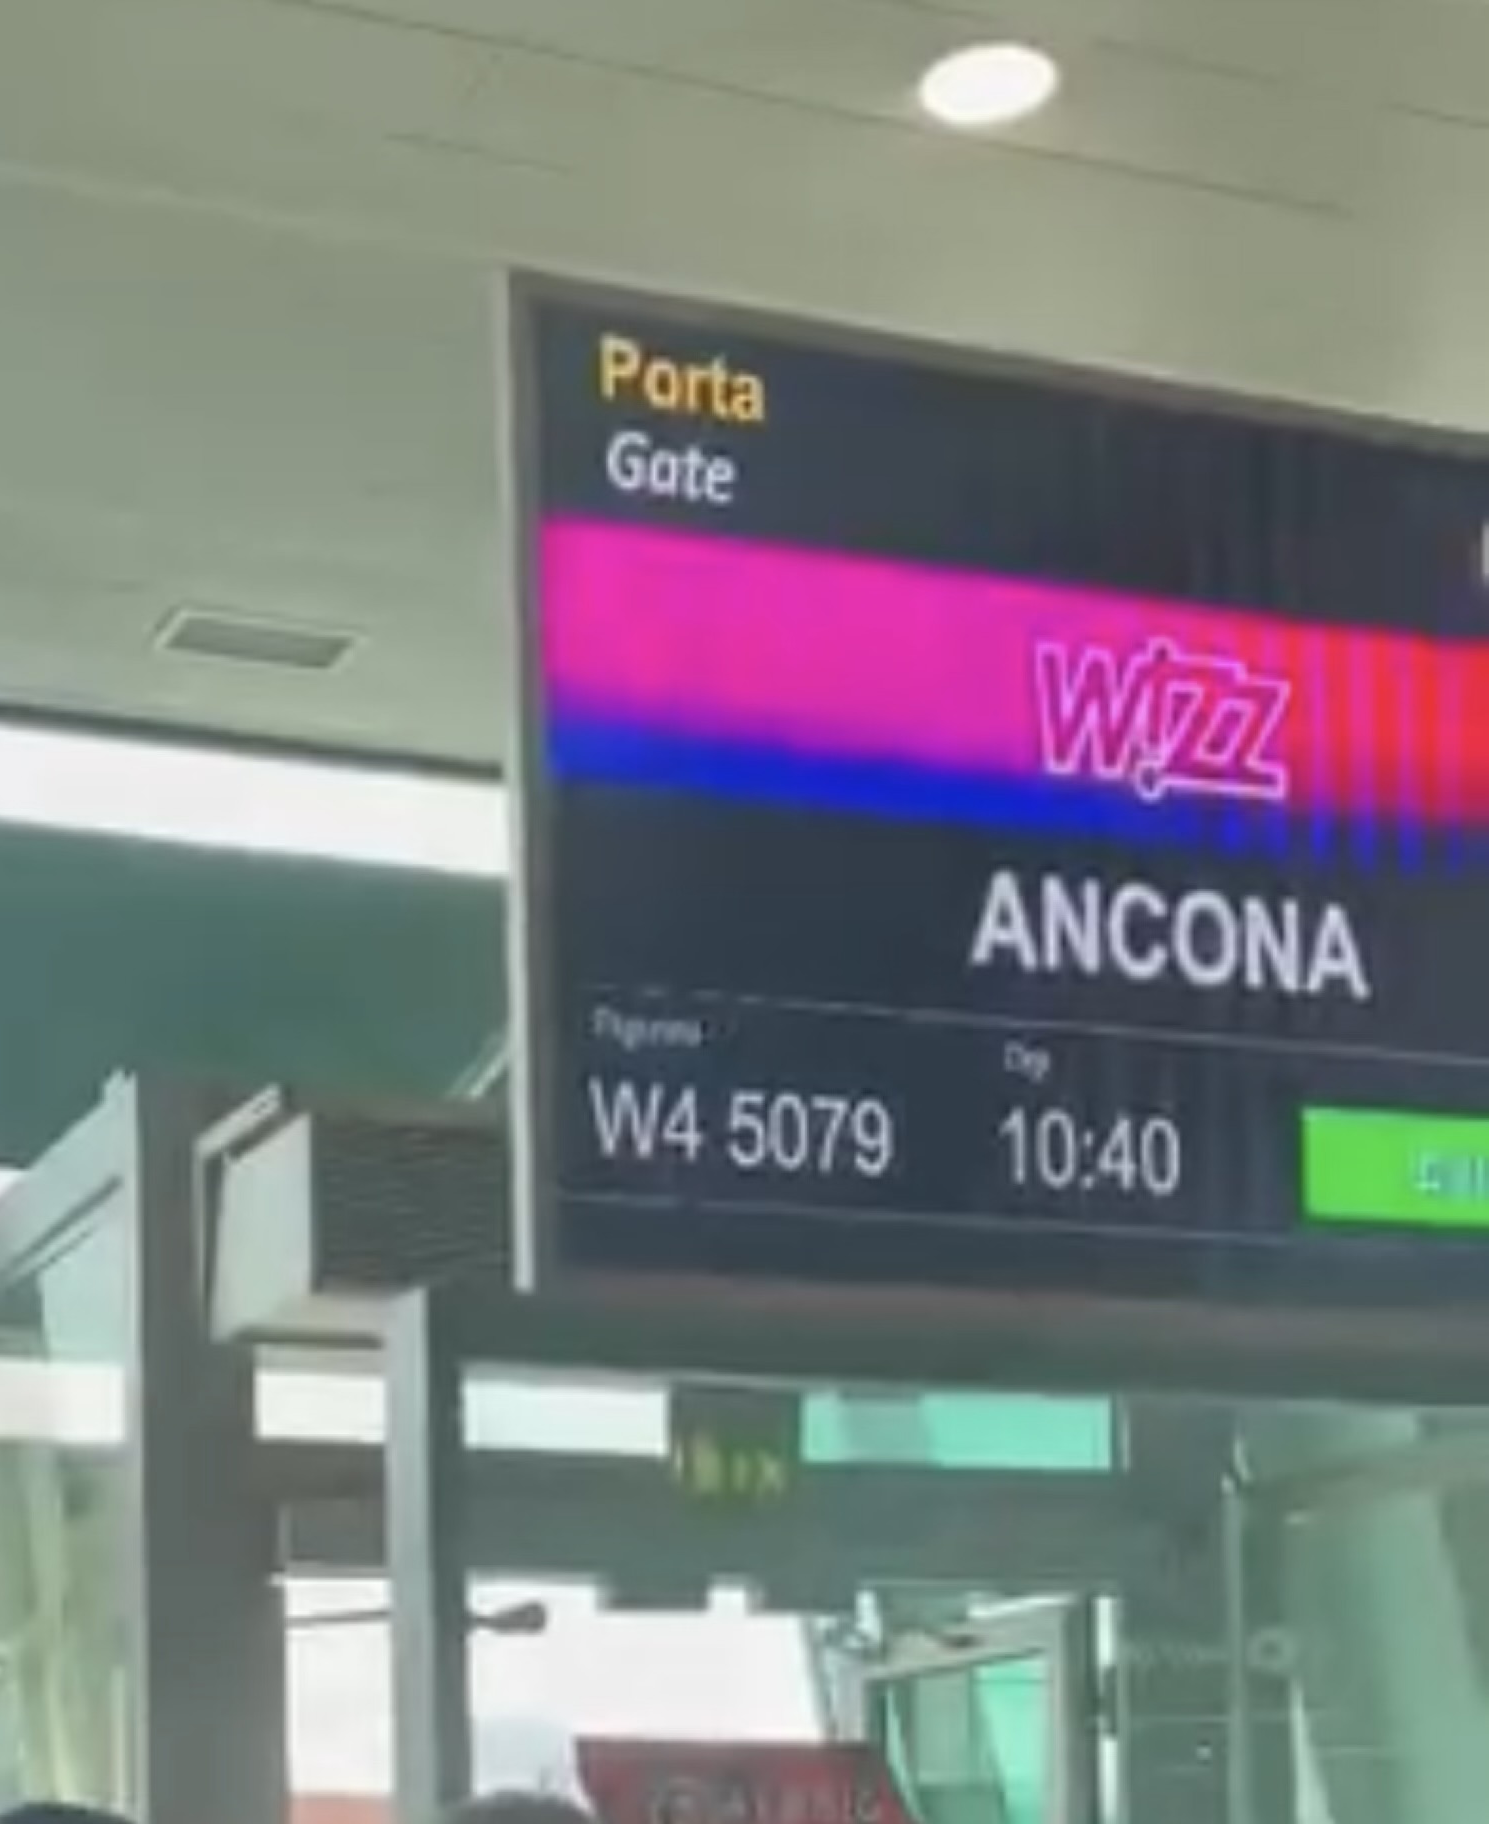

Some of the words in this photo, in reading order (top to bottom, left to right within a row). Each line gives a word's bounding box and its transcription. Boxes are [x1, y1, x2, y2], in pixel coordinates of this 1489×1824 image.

[598, 333, 765, 422] Porta
[605, 430, 736, 504] Gate
[971, 870, 1370, 999] ANCONA
[588, 1077, 705, 1162] W4
[725, 1087, 894, 1177] 5079
[999, 1107, 1181, 1197] 10:40
